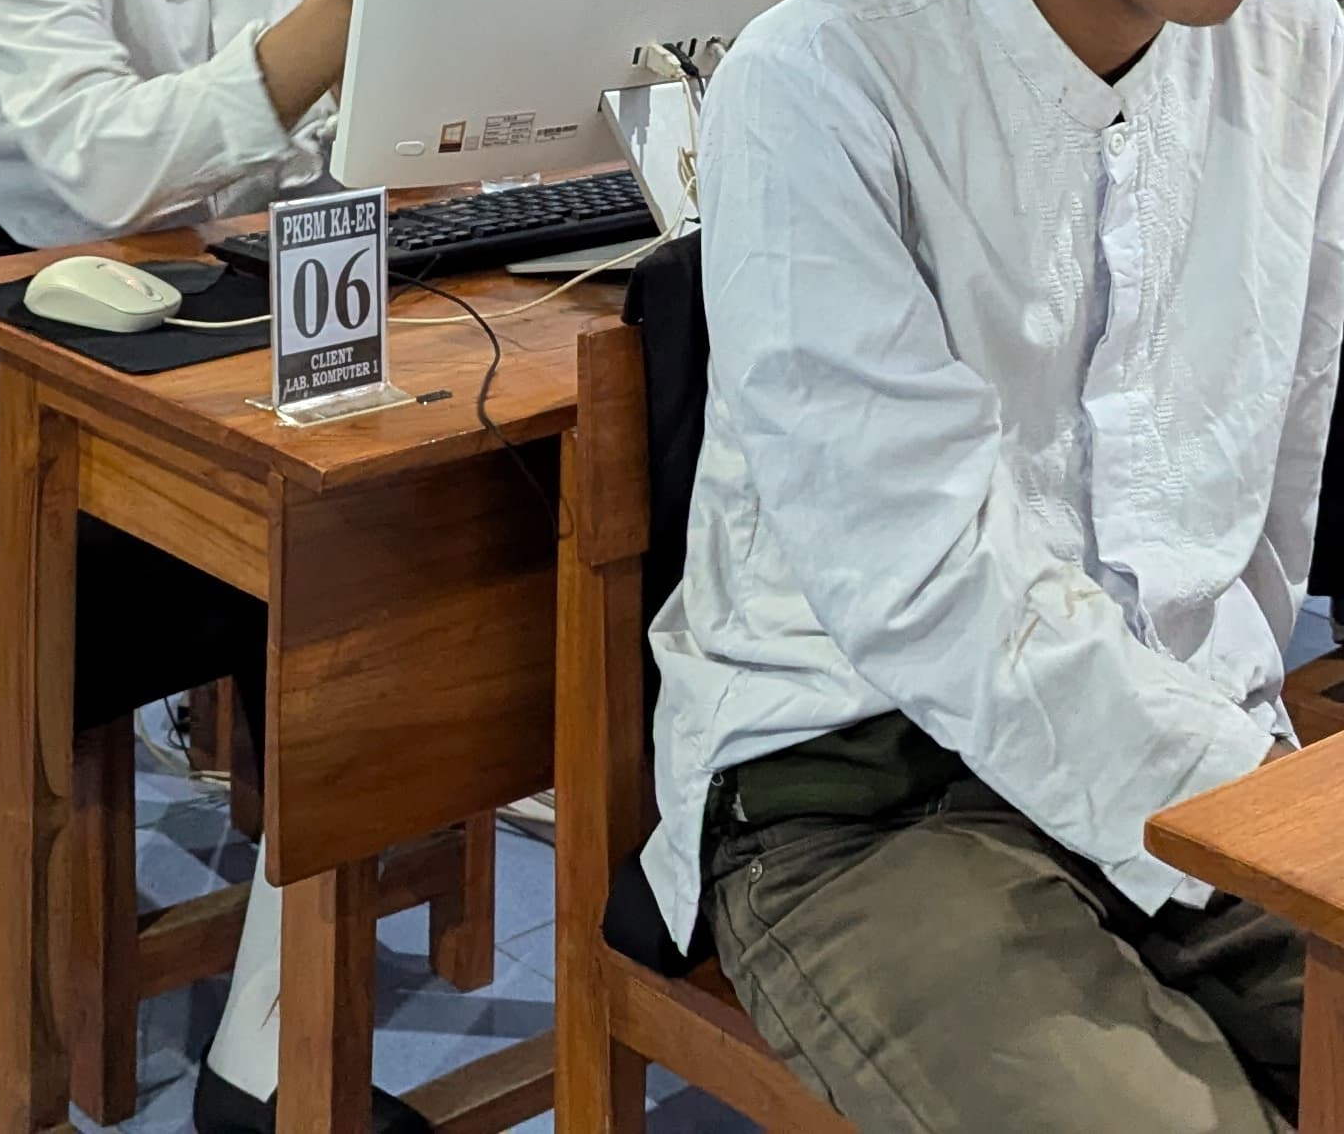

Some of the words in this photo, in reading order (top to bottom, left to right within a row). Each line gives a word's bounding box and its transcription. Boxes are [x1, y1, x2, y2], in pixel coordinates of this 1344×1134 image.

[282, 210, 326, 245] PKBM
[330, 202, 376, 237] KA-ER
[293, 247, 371, 339] 06
[286, 375, 310, 393] LAB.
[312, 361, 371, 387] KOMPUTER
[373, 359, 378, 373] 1
[311, 346, 354, 370] CLIENT
